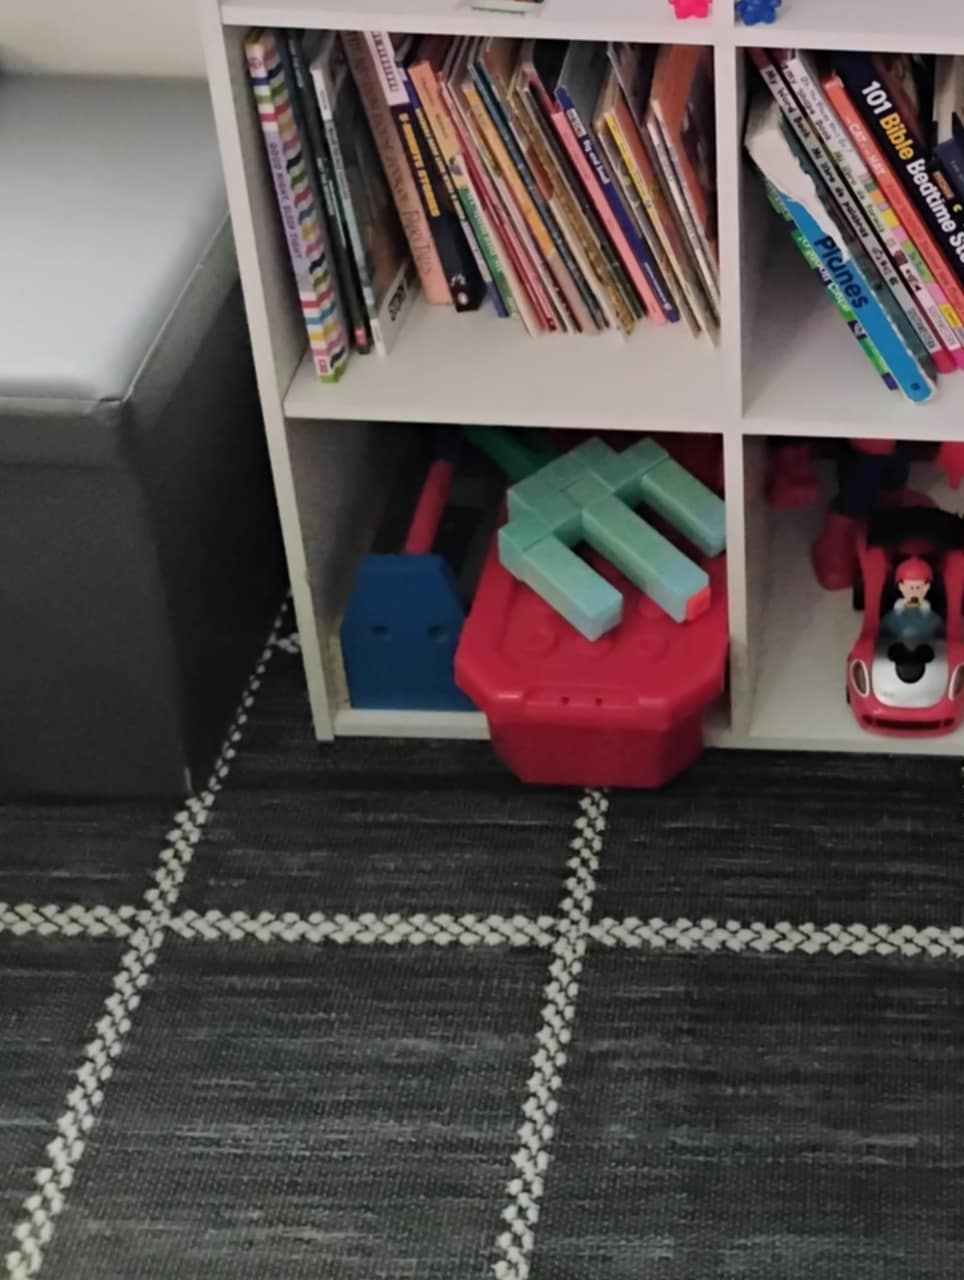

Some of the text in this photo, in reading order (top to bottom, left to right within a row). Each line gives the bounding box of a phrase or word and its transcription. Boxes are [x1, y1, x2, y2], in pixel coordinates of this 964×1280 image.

[762, 67, 813, 140] My Word Book
[268, 141, 284, 171] GOOD
[847, 121, 887, 179] CAT HAT
[858, 78, 893, 117] 101
[876, 109, 920, 163] Bible
[903, 155, 962, 236] Bedtime
[810, 144, 870, 240] Mi libro de palabras
[855, 188, 867, 200] de
[810, 232, 874, 312] Planes
